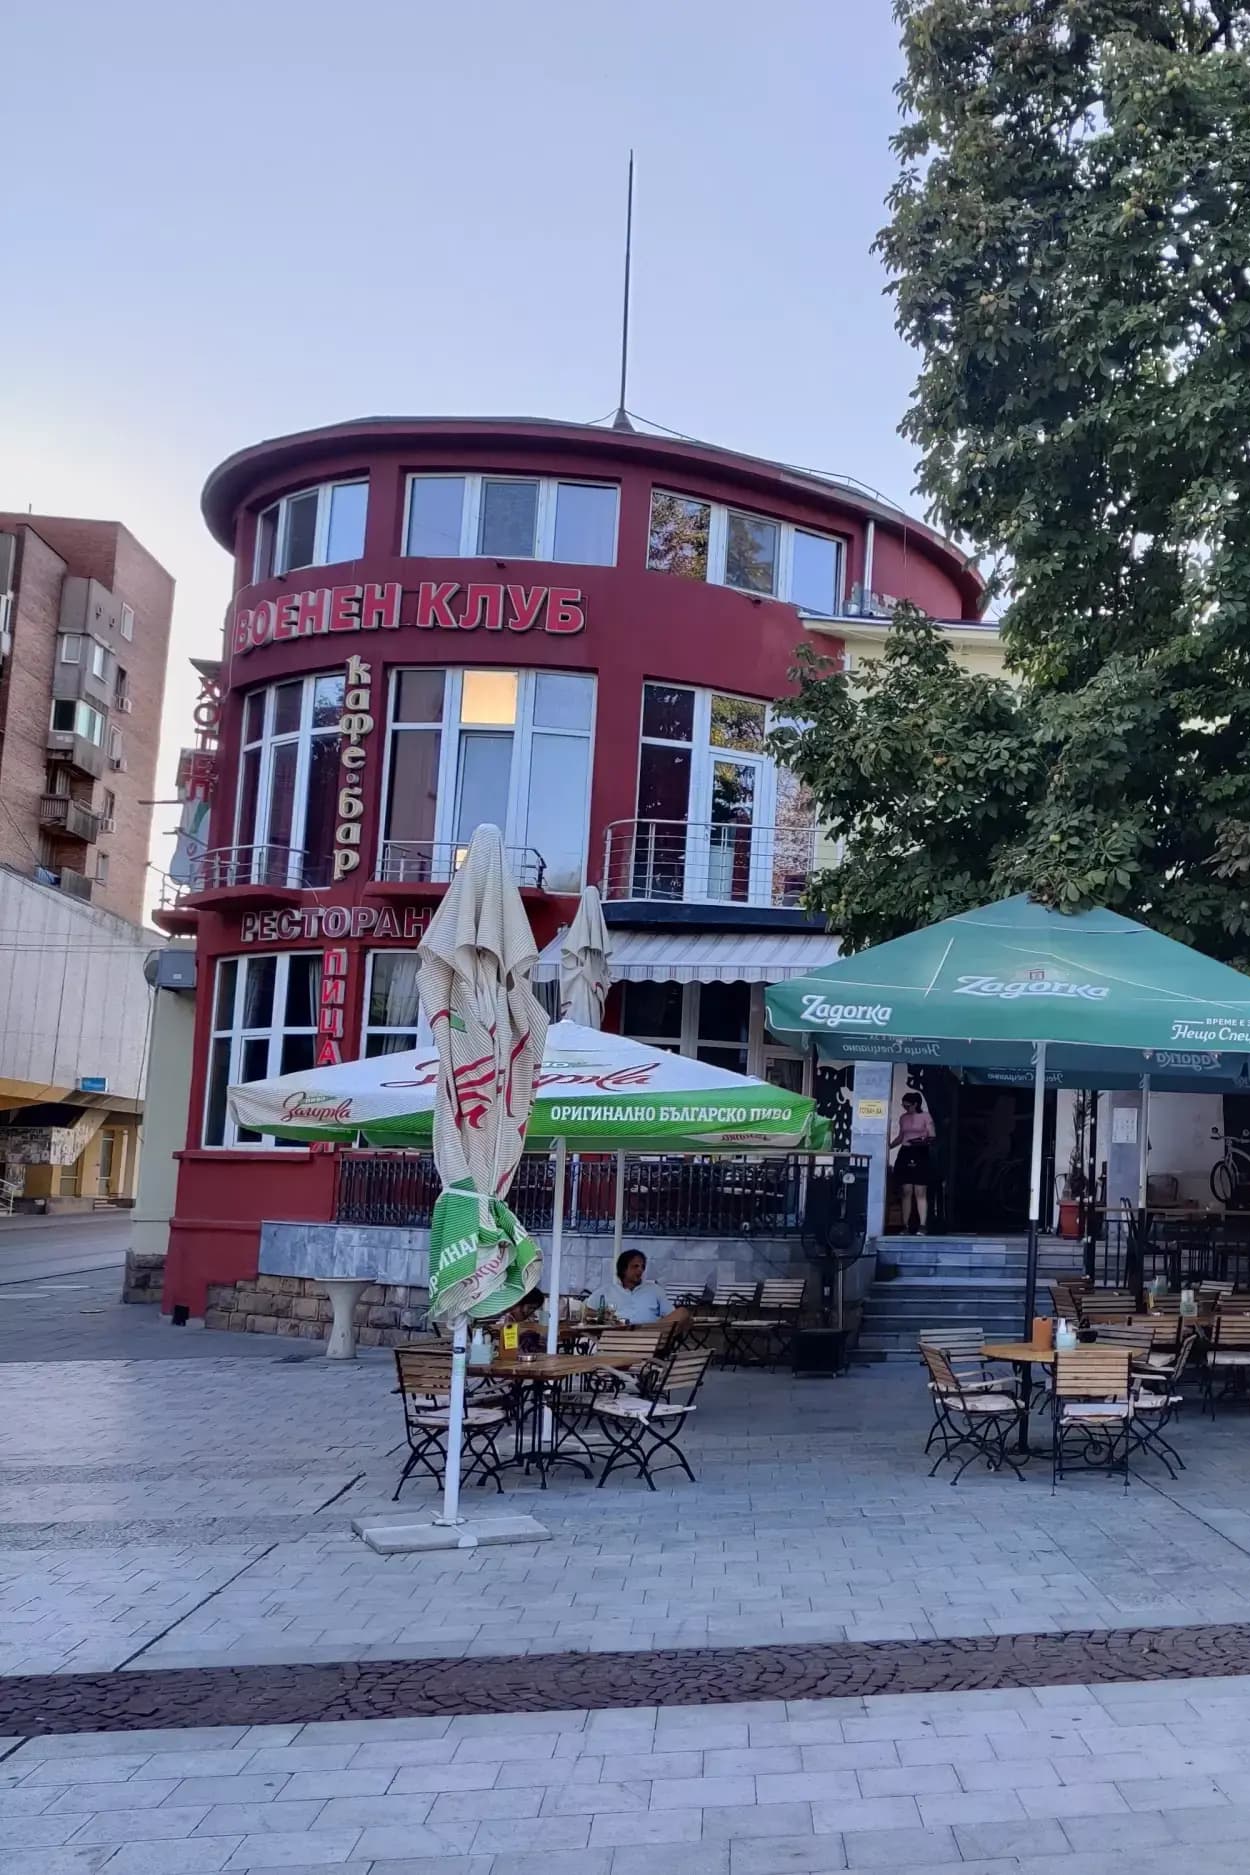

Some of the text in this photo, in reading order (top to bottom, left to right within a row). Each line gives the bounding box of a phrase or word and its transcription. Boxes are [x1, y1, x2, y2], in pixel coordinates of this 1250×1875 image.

[230, 582, 586, 654] ВОЕНЕН КЛУБ
[241, 905, 434, 943] РЕСТОРАН
[954, 975, 1112, 1001] Zagorka
[316, 947, 347, 1066] ПИЦА
[800, 994, 893, 1027] Zagorka
[1171, 1023, 1217, 1041] Нещо
[1206, 1018, 1237, 1026] ВРЕМЕ
[551, 1105, 793, 1123] ОРИГИНАЛНО БЪЛГАРСКО ПИВО
